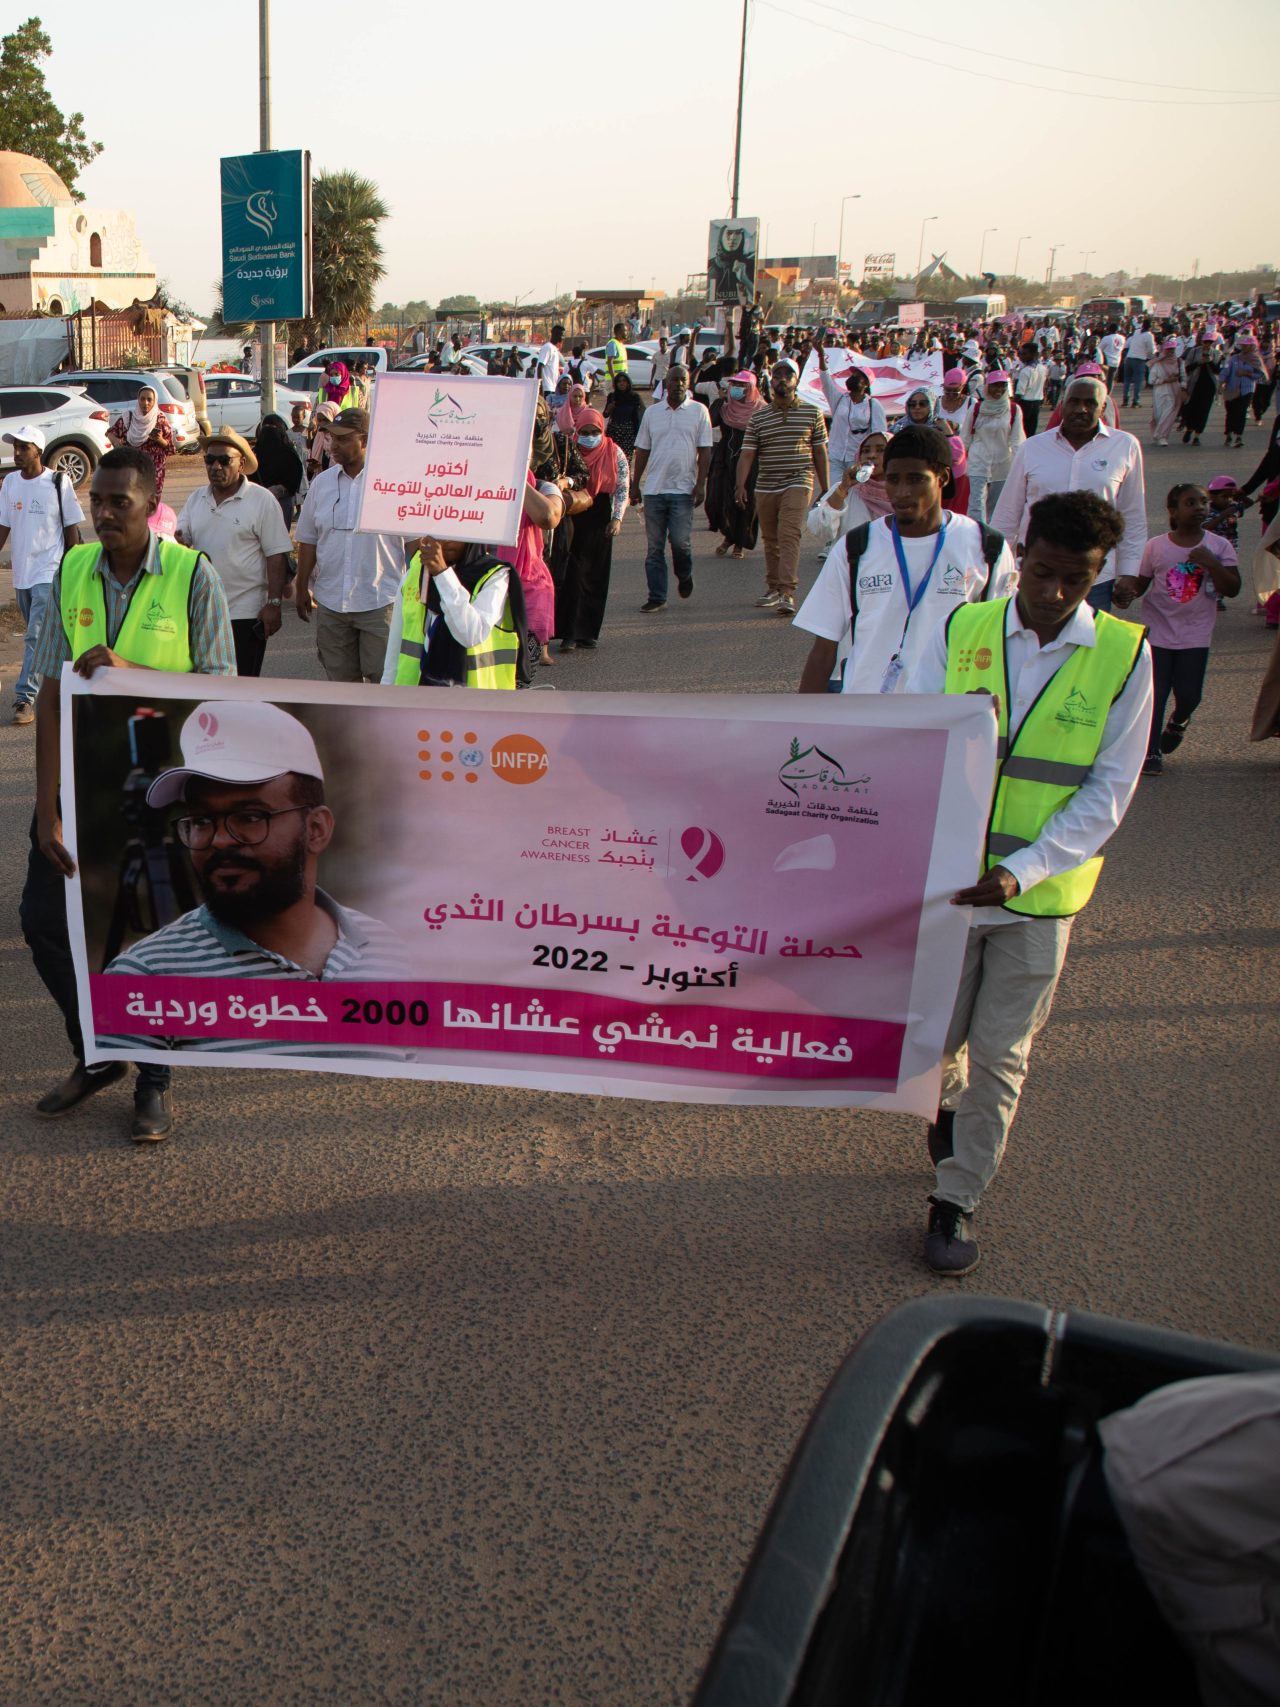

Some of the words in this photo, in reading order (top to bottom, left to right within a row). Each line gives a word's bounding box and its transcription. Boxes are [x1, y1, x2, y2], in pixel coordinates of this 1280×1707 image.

[280, 250, 296, 259] Bank
[237, 269, 263, 280] جديدة
[425, 460, 468, 478] أكتوبر
[373, 478, 422, 495] للتوعية
[424, 485, 472, 501] العالمي
[474, 485, 517, 501] الشهر
[397, 502, 430, 521] الثدي
[433, 505, 485, 524] بسرطان
[489, 750, 549, 771] UNFPA
[767, 799, 800, 809] الخيرية
[806, 801, 840, 812] صدقات
[847, 805, 879, 817] منظمة
[765, 808, 800, 817] Sadagaat
[801, 810, 829, 820] Charity
[830, 813, 879, 826] Organization
[547, 825, 591, 838] BREAST
[541, 838, 590, 850] CANCER
[520, 850, 591, 864] AWARENESS
[423, 893, 504, 930] الثدي
[514, 901, 640, 942] بسرطان
[651, 913, 769, 956] التوعية
[778, 935, 863, 960] حملة
[532, 944, 609, 973] 2022
[642, 961, 739, 992] أكتوبر
[125, 991, 219, 1027] وردية
[227, 994, 328, 1029] خطوة
[340, 998, 429, 1027] 2000
[442, 997, 580, 1036] عشانها
[592, 1011, 718, 1054] نمشي
[730, 1027, 854, 1065] فعالية
